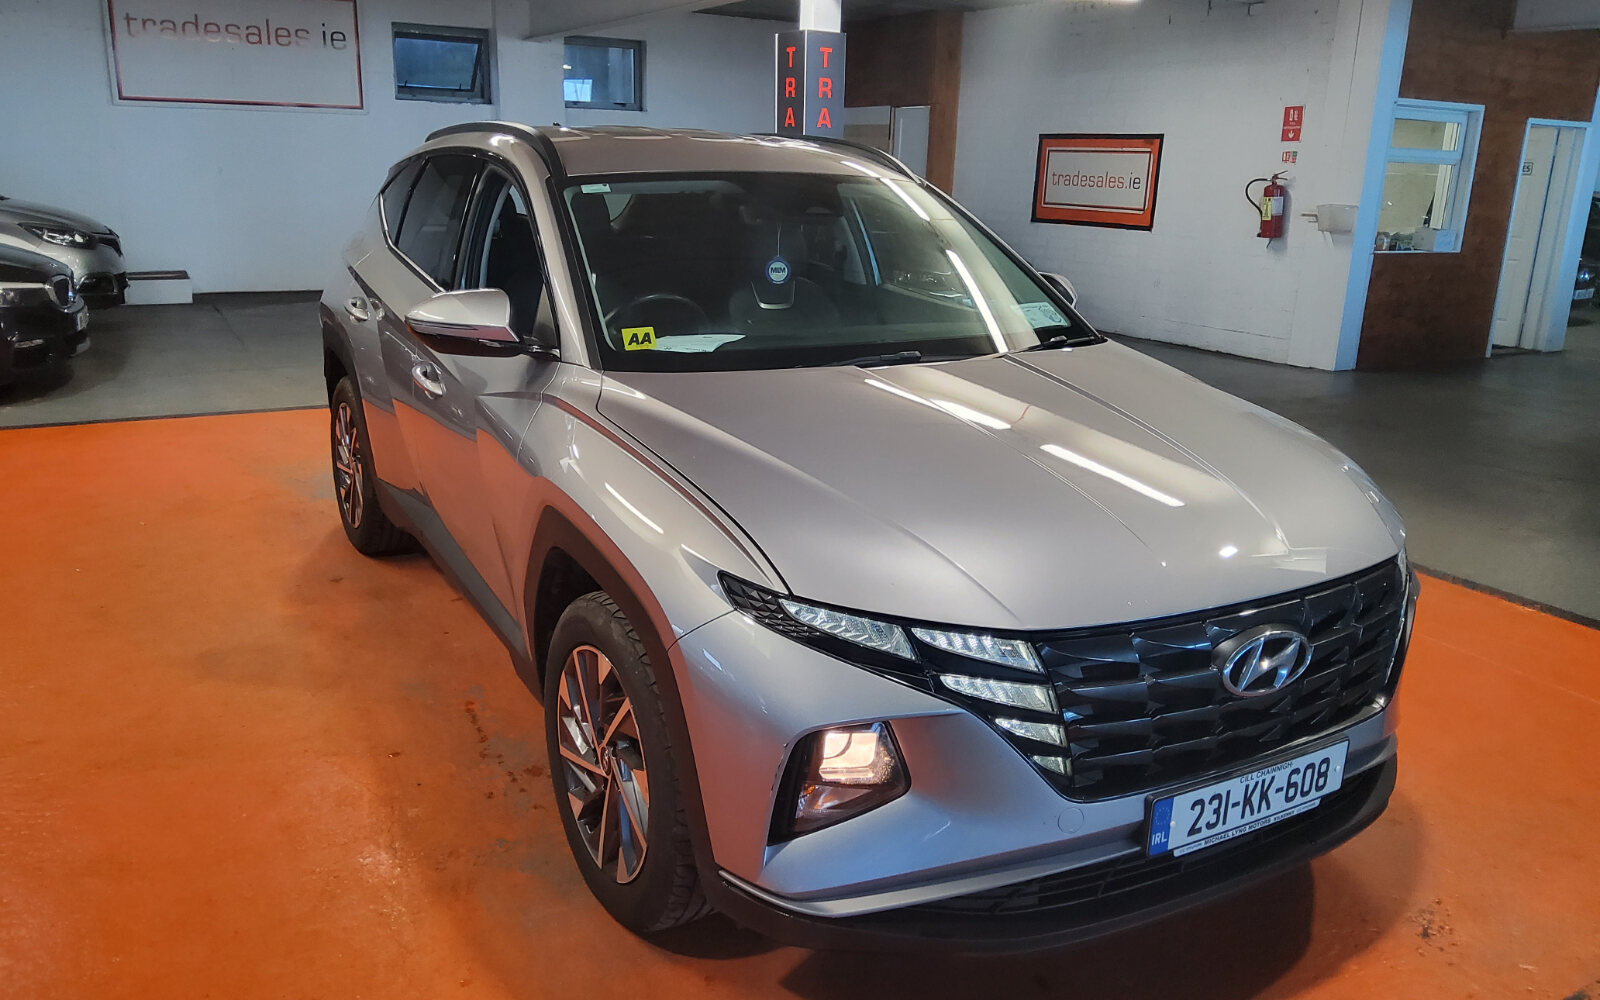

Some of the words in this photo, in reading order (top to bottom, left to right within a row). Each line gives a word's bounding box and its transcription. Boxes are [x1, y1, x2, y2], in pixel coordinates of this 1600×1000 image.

[1052, 170, 1141, 190] tradesales.ie
[627, 332, 652, 346] AA
[1186, 757, 1331, 838] 231-KK-608
[1151, 832, 1168, 846] IRL
[1203, 831, 1231, 846] MICHAEL
[1247, 817, 1272, 831] MOTORS
